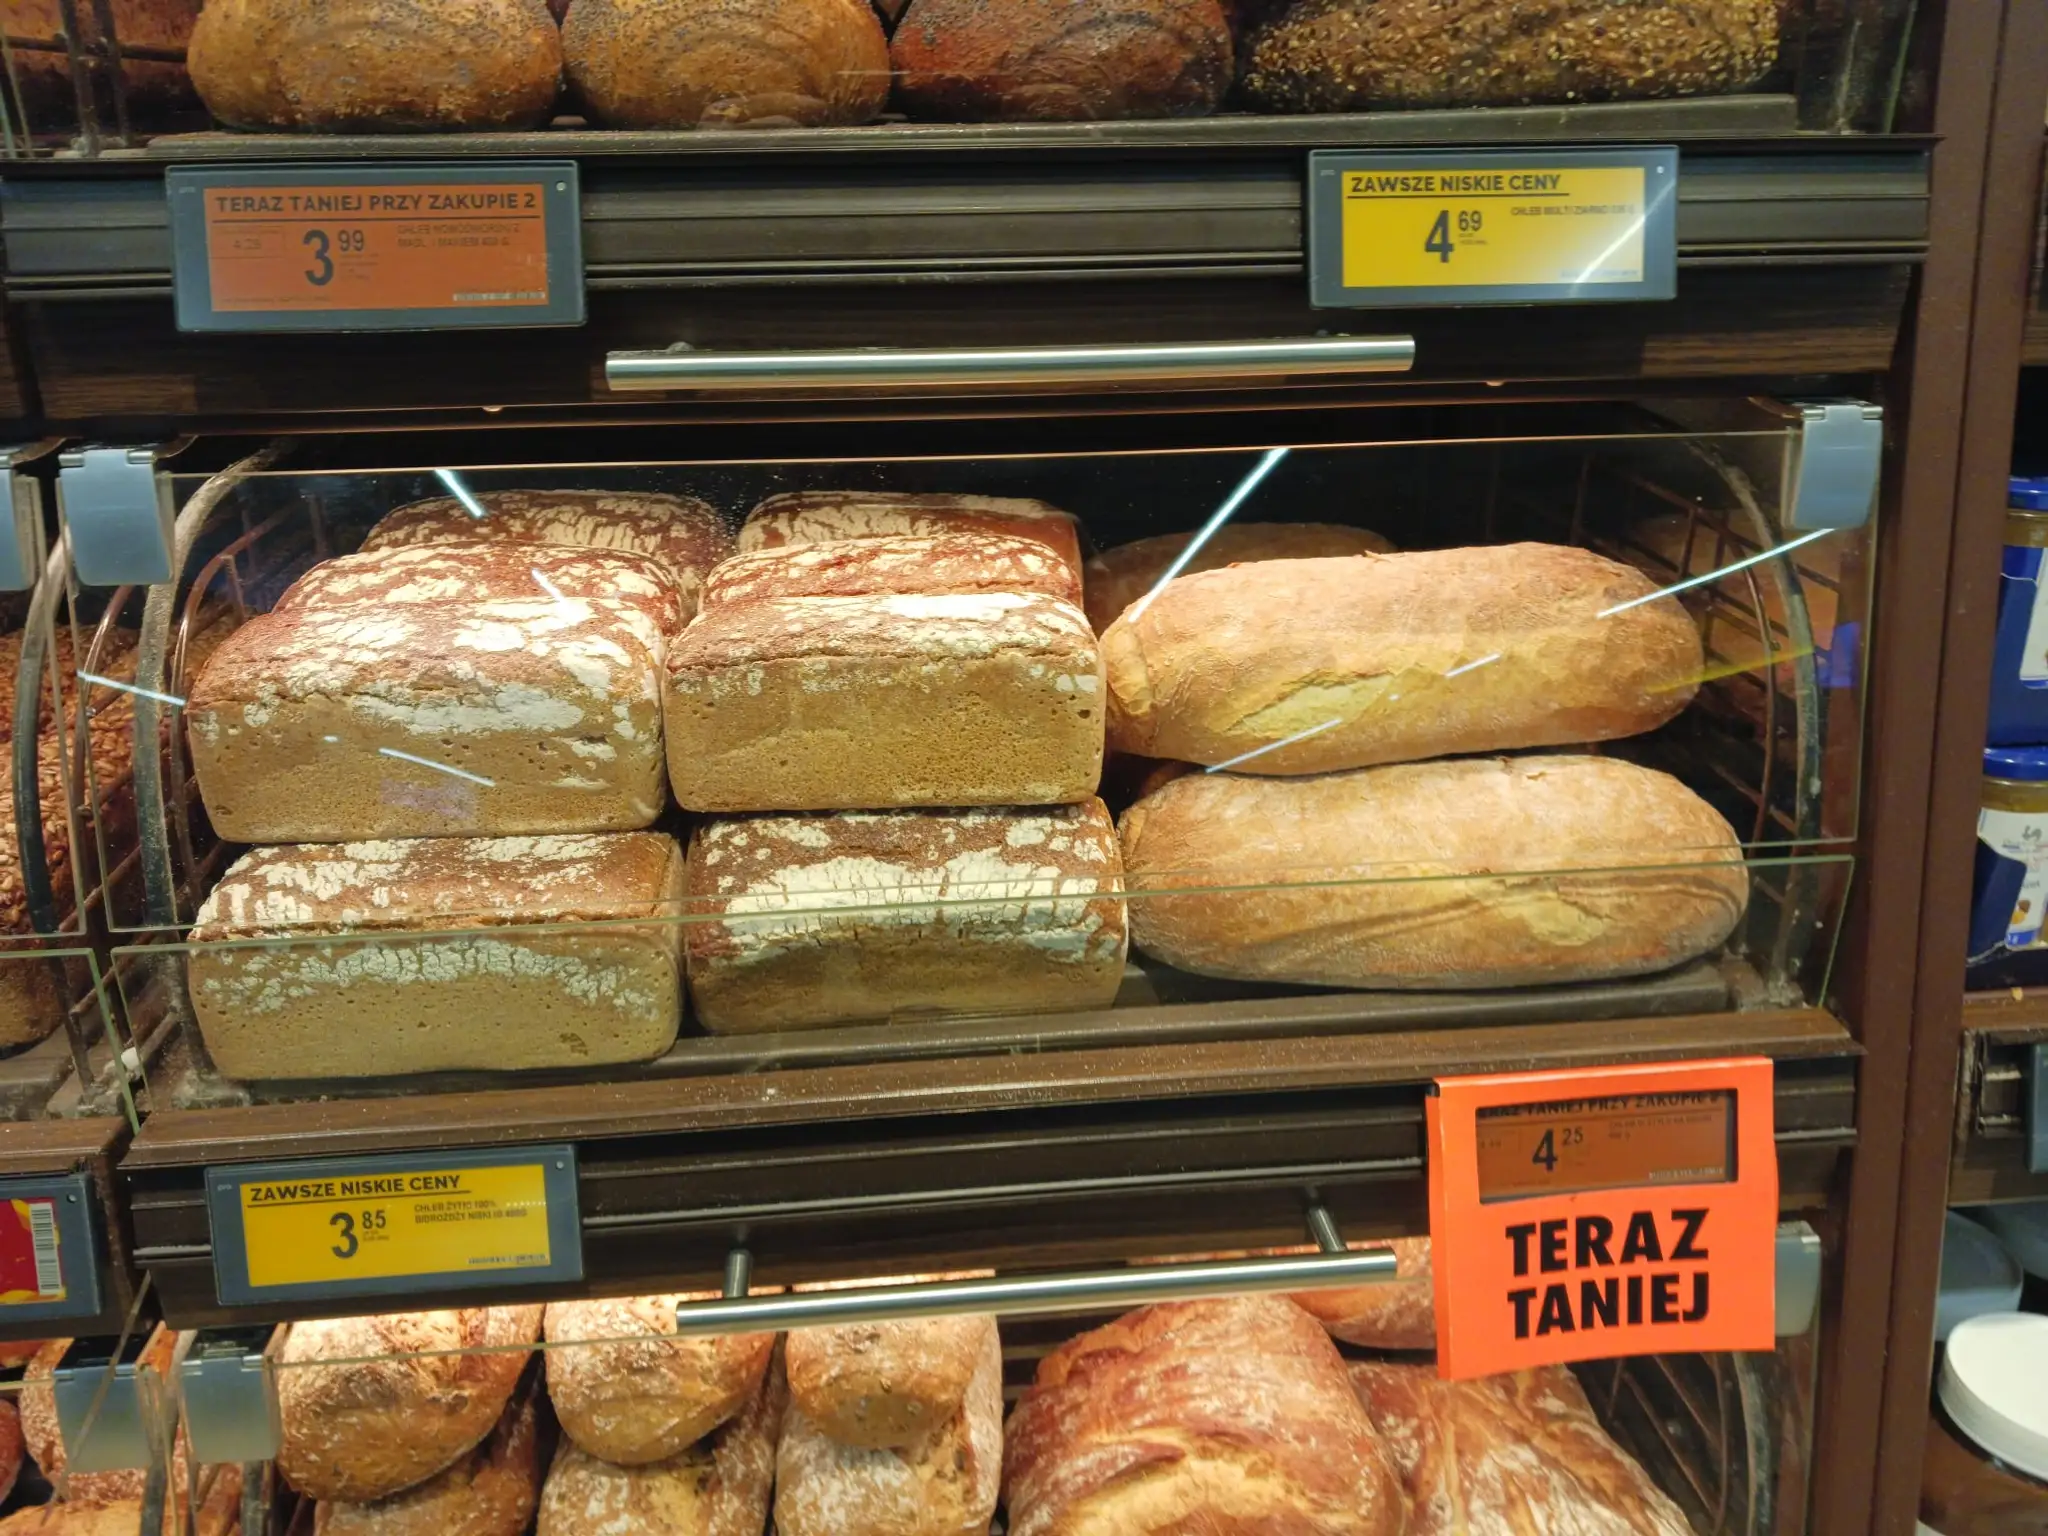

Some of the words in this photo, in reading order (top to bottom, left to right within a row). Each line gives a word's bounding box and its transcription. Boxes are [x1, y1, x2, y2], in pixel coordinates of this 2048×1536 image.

[216, 196, 284, 212] TERAZ
[289, 195, 362, 212] TANIEJ
[370, 194, 422, 211] PRZY
[429, 193, 519, 210] ZAKUPIE
[524, 192, 536, 208] 2
[1351, 176, 1435, 192] ZAWSZE
[1441, 175, 1504, 191] NISKIE
[1508, 174, 1561, 190] CENY
[302, 229, 334, 286] 3
[338, 230, 364, 251] 99
[1424, 209, 1455, 263] 4
[1458, 210, 1482, 232] 69
[1532, 1128, 1558, 1172] 4
[1562, 1127, 1584, 1145] 25
[251, 1183, 336, 1201] ZAWSZE
[341, 1178, 405, 1195] NISKIE
[409, 1175, 461, 1191] CENY
[329, 1212, 359, 1259] 3
[362, 1210, 386, 1229] 85
[1505, 1208, 1709, 1278] TERAZ
[1507, 1271, 1709, 1341] TANIEJ
